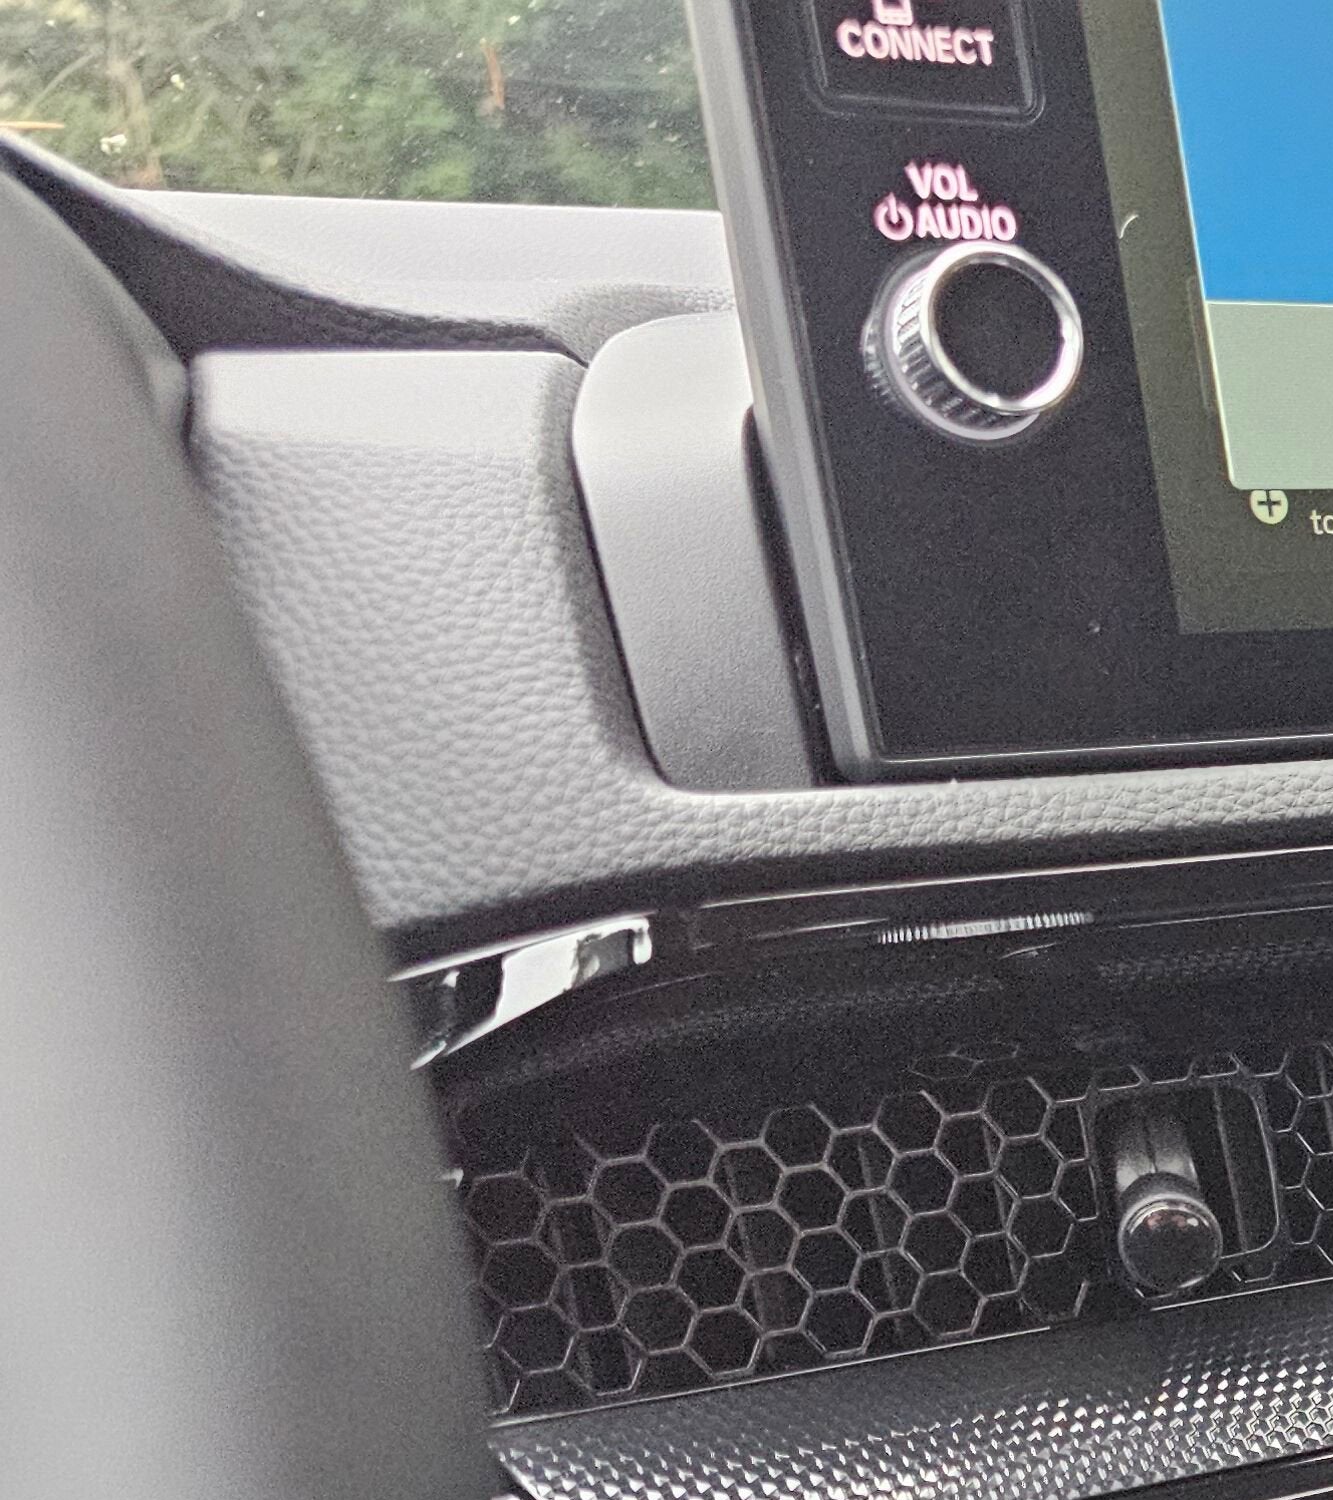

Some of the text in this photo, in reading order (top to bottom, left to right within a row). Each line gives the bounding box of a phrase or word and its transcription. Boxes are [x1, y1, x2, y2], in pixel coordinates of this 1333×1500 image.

[836, 18, 995, 67] CONNECT
[904, 161, 979, 201] VOL
[914, 202, 1018, 241] AUDIO
